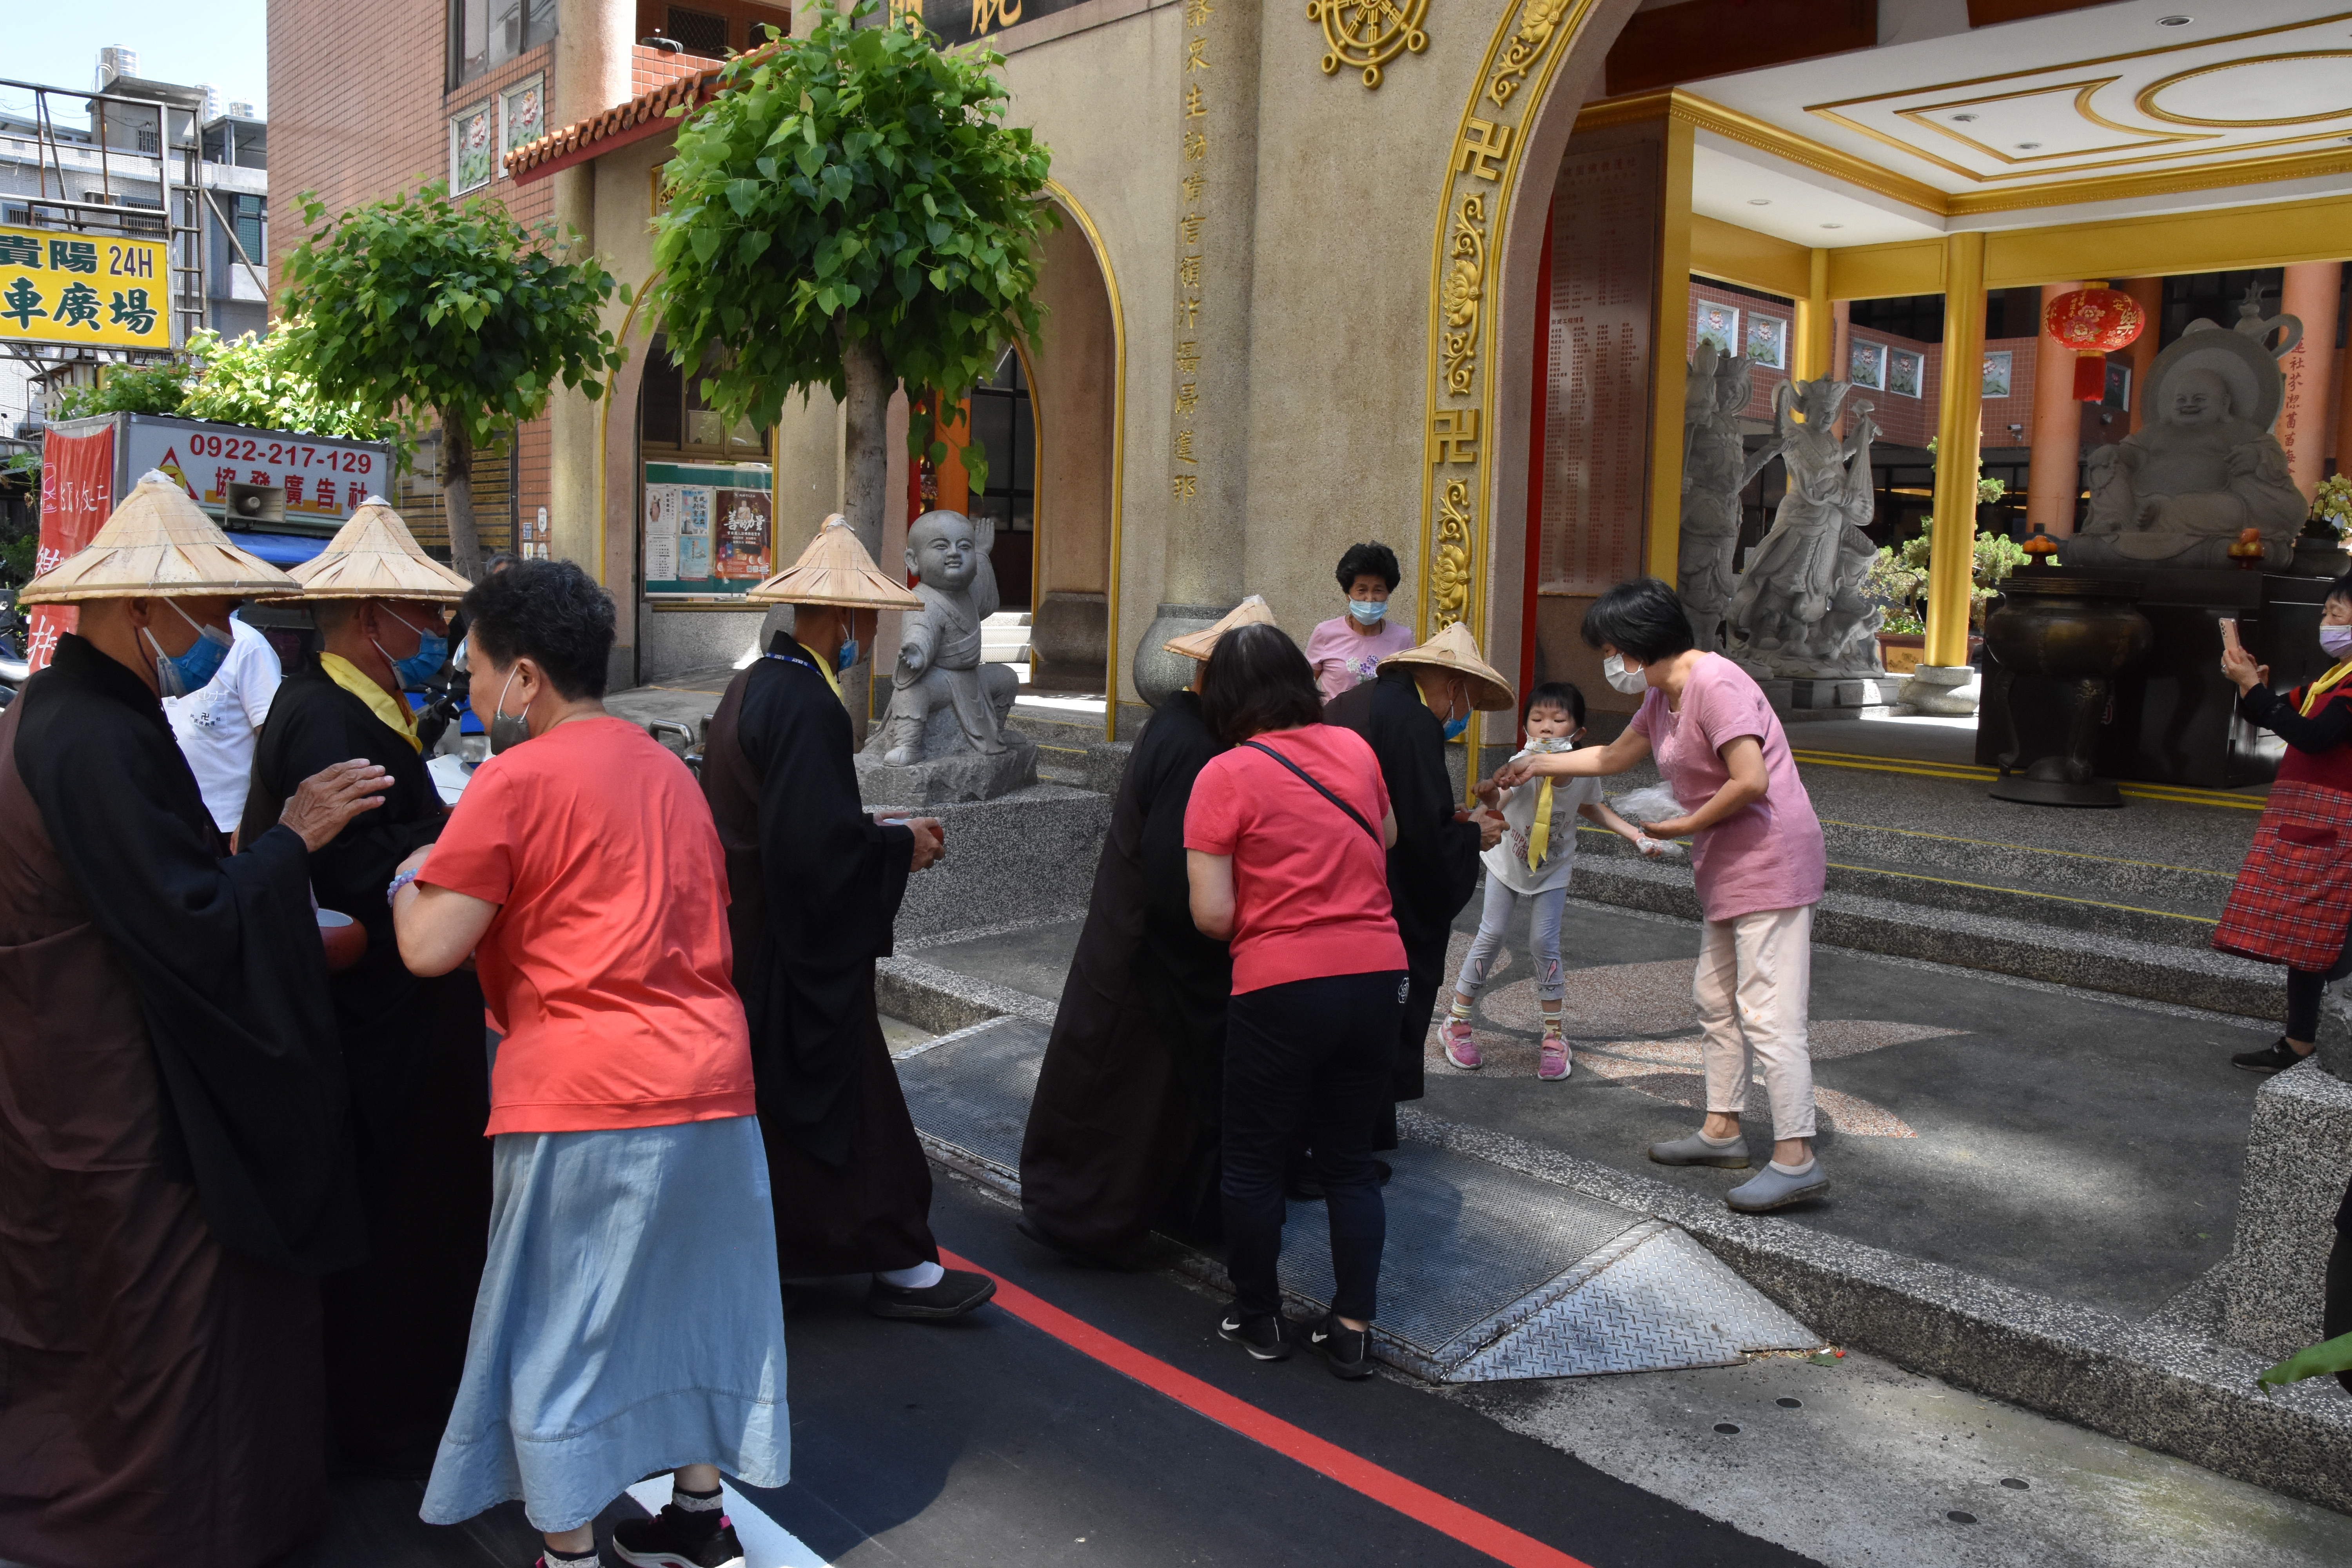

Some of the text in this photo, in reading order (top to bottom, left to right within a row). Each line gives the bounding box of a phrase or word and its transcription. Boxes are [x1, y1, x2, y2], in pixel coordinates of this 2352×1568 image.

[0, 235, 152, 278] 貴陽 24H
[0, 277, 157, 334] 車廣場
[190, 434, 372, 474] 0922-217-129
[1510, 829, 1529, 850] SUPE
